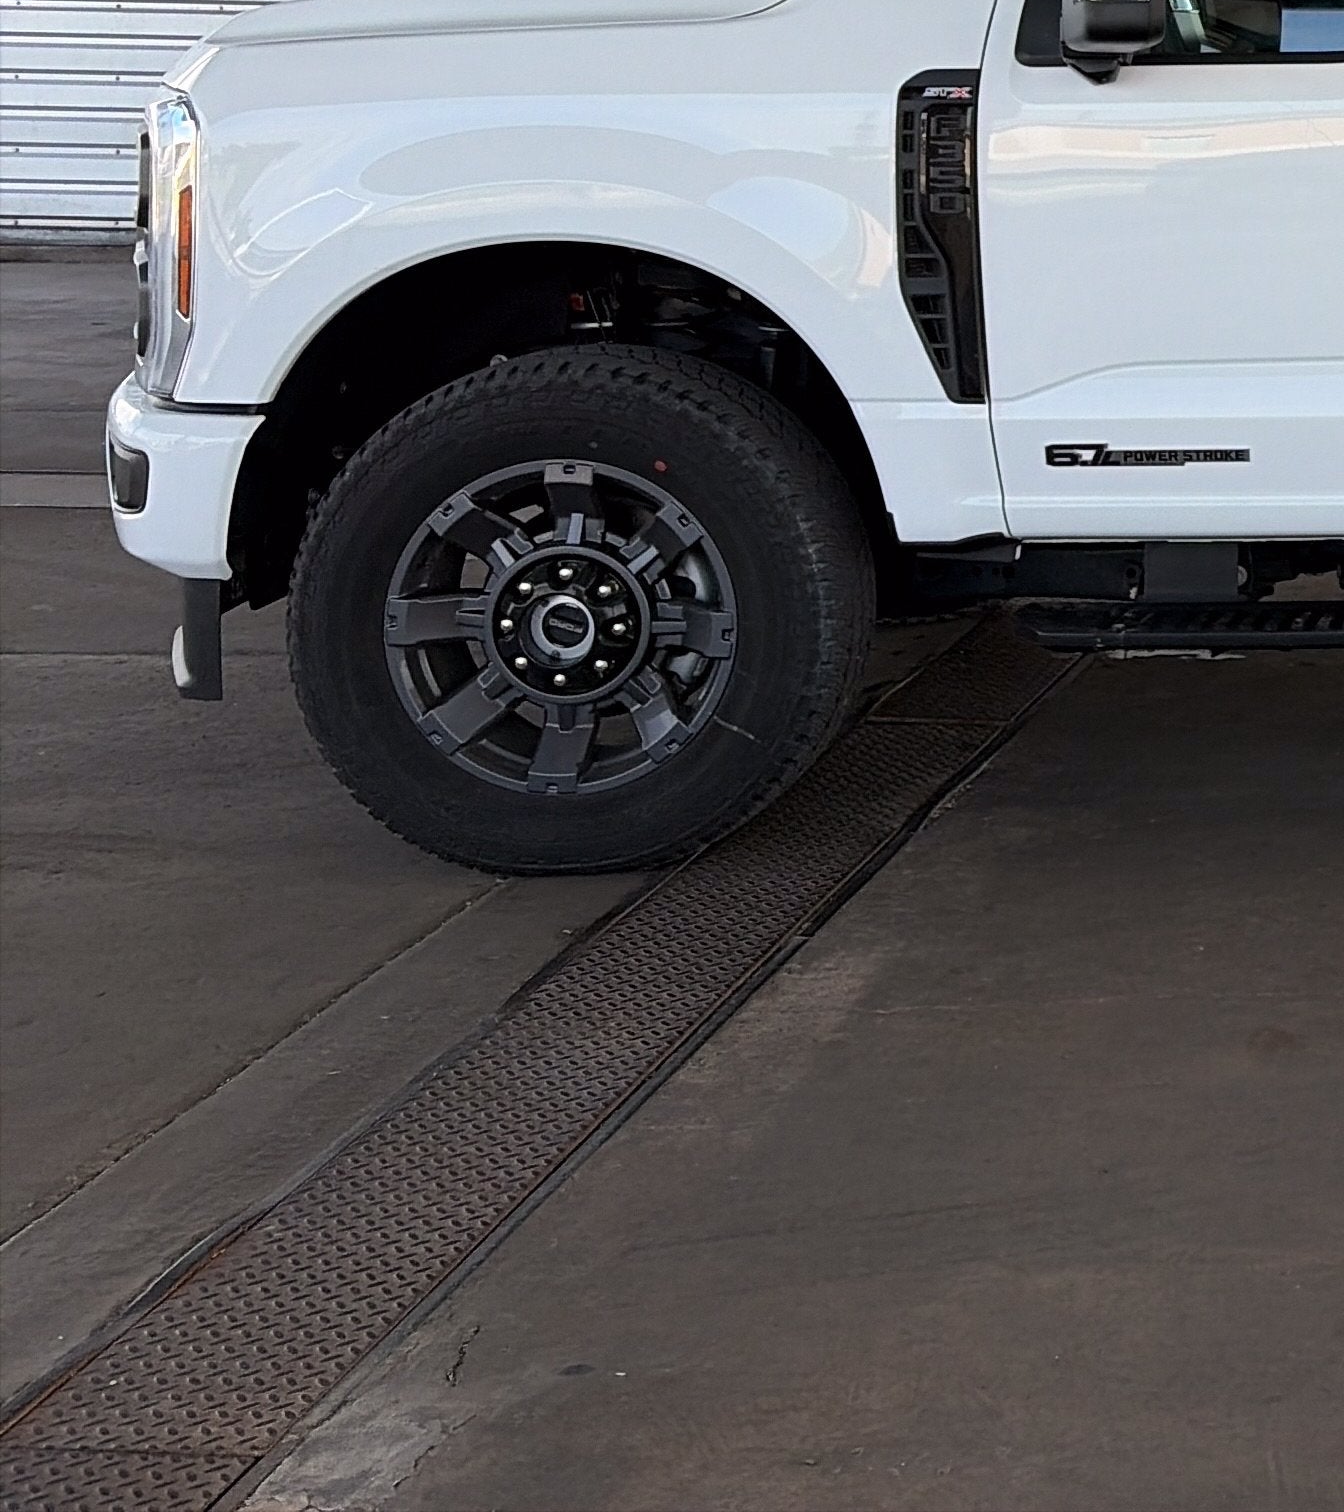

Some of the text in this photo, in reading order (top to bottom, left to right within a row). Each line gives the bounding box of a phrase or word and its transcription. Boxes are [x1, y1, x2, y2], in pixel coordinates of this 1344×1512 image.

[922, 86, 973, 99] STX
[1123, 449, 1178, 462] POWER
[1183, 449, 1246, 462] STROKE
